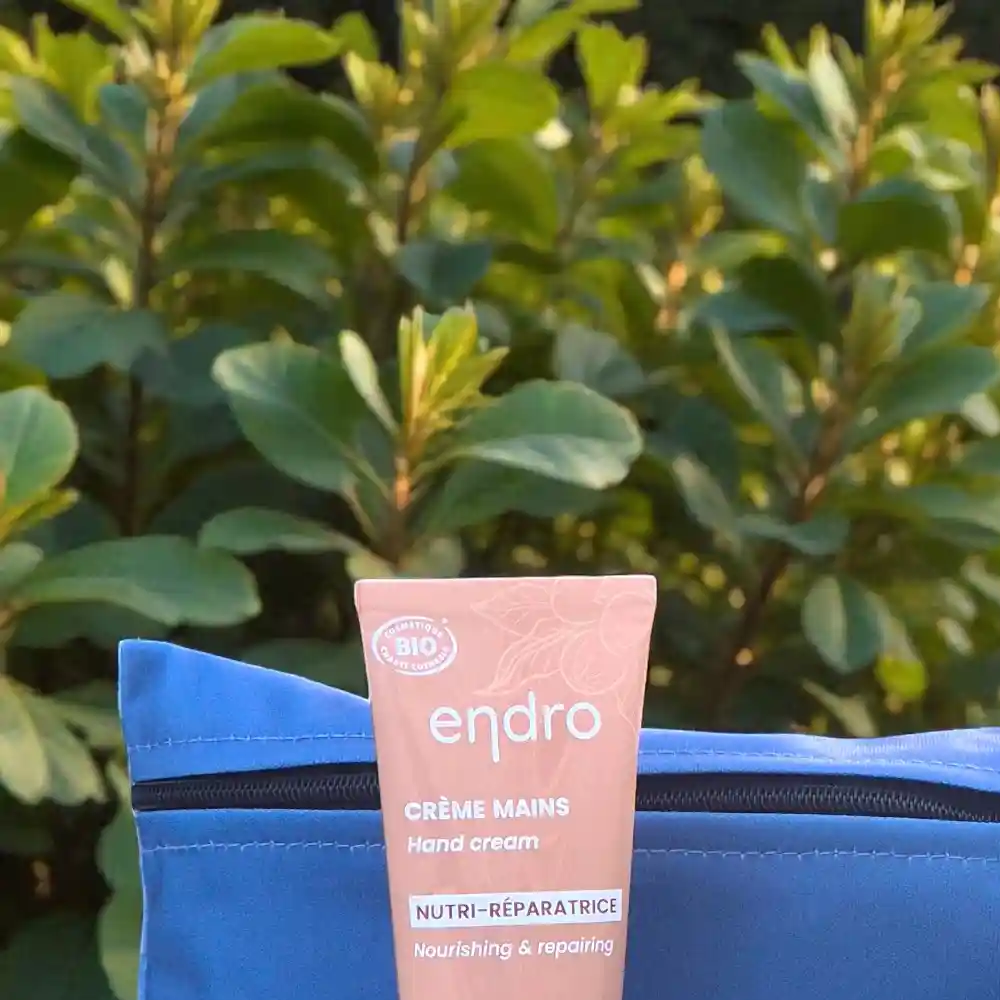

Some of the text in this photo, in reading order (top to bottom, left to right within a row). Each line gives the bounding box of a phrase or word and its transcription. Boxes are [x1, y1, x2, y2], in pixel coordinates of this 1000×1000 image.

[396, 637, 436, 656] BIO
[429, 692, 602, 763] endro
[404, 797, 569, 821] CRÈME MAINS
[408, 835, 539, 853] Hand cream
[416, 897, 617, 920] NUTRI-RÉPARATRICE
[414, 937, 613, 960] Nourishing & repairing
